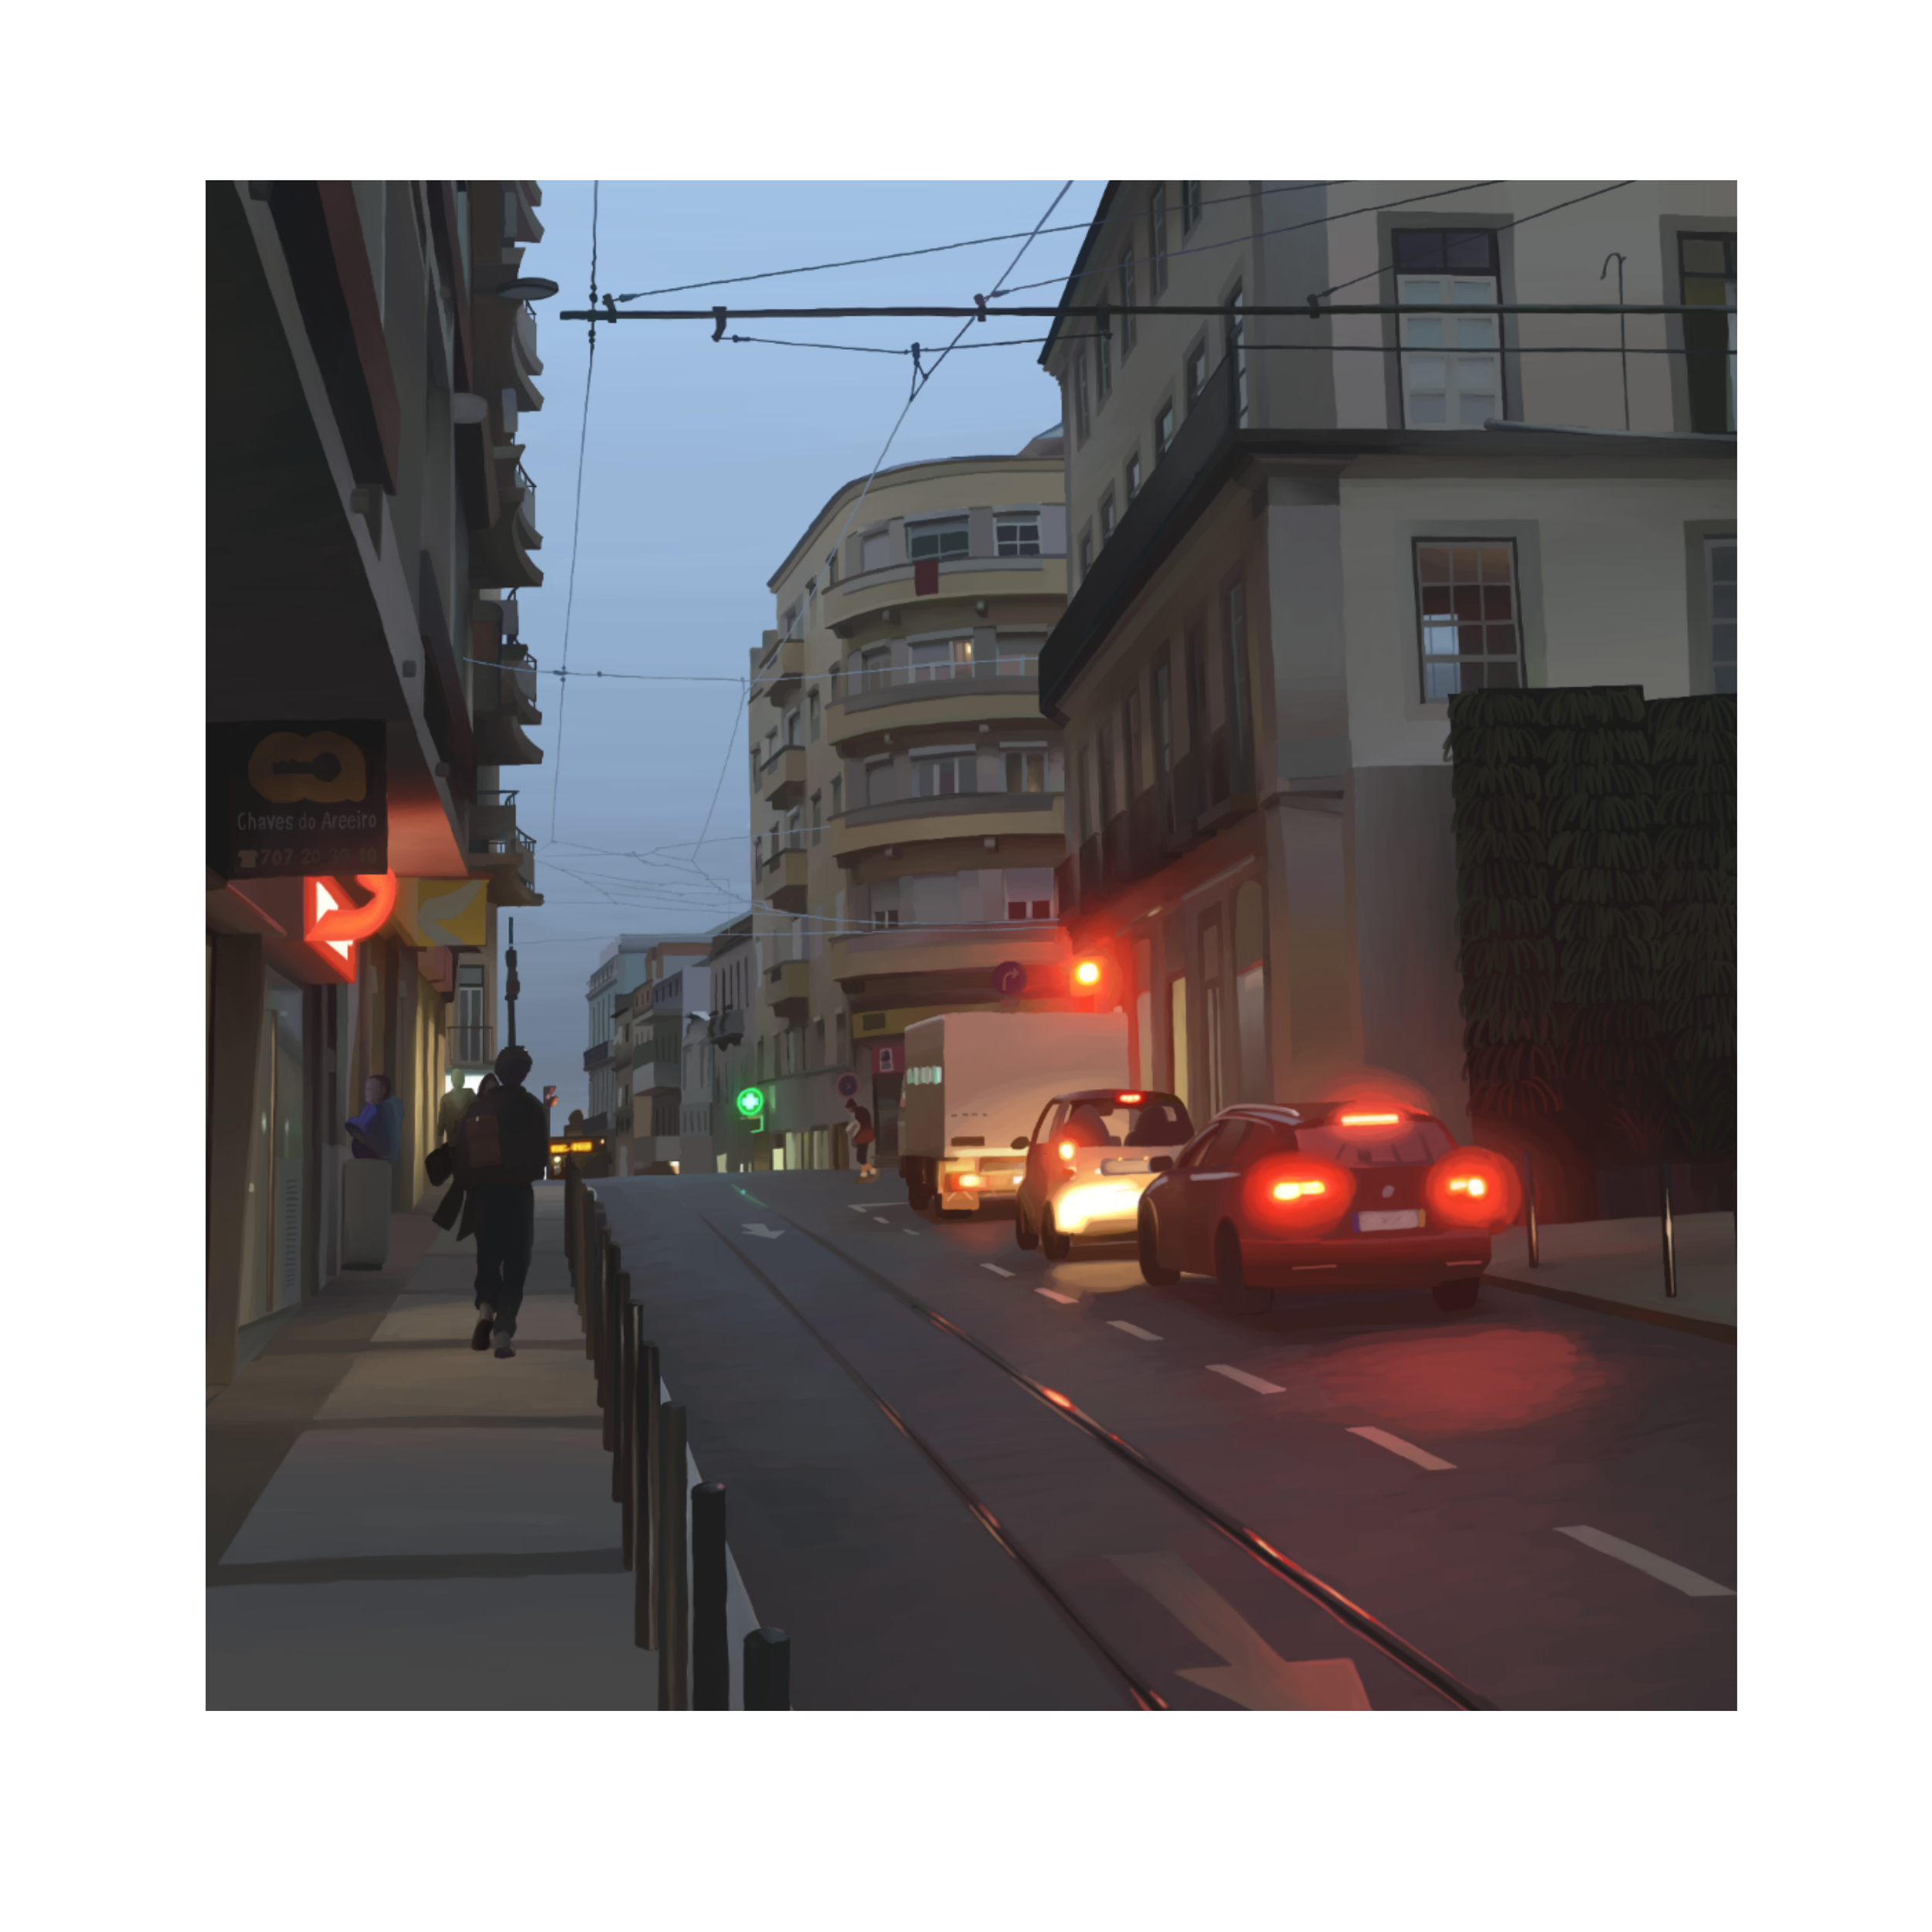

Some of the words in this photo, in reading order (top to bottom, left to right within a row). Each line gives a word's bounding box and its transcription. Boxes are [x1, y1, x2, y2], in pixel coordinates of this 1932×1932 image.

[237, 811, 294, 831] Chaves
[298, 811, 317, 830] do
[321, 809, 377, 830] Areeiro
[260, 848, 295, 866] 707
[300, 847, 321, 865] 20
[328, 846, 350, 866] 30
[358, 846, 377, 865] 10
